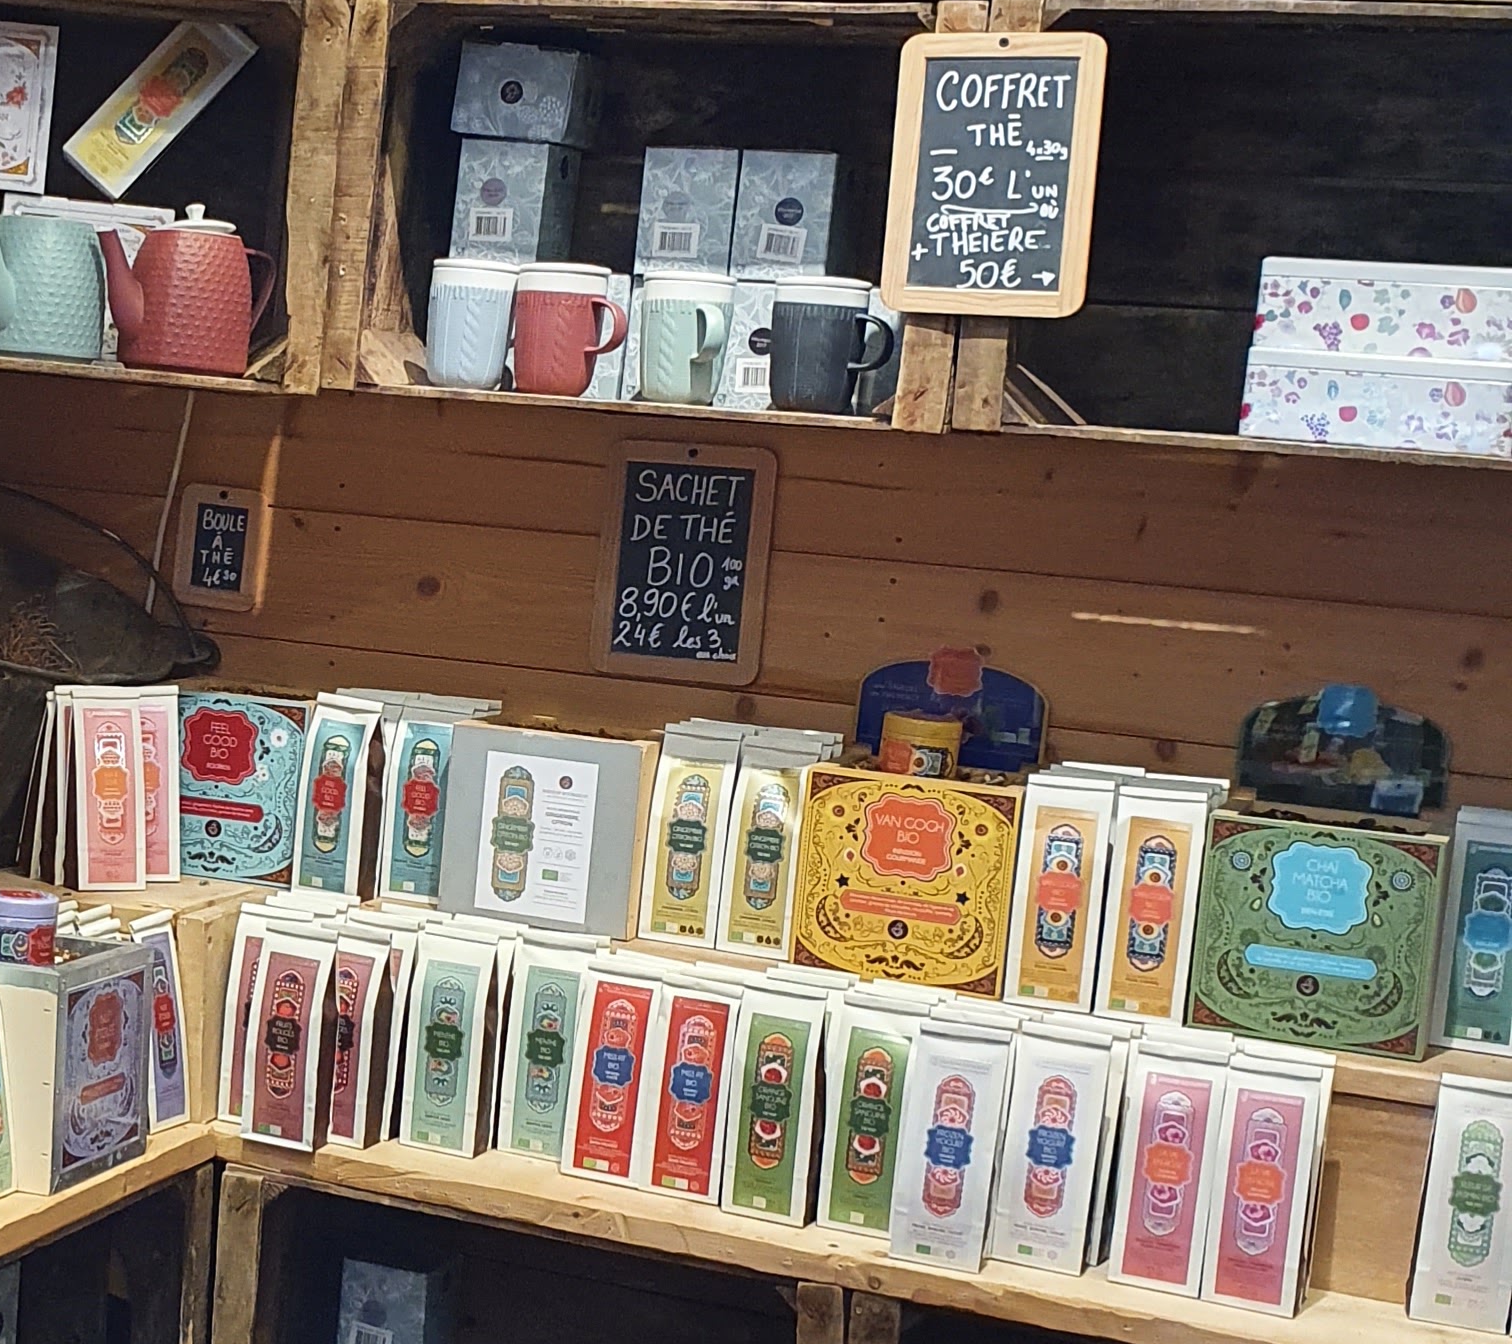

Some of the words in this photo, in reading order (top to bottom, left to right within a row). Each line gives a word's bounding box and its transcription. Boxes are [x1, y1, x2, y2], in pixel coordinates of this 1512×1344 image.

[936, 70, 1072, 112] COFFRET
[931, 165, 995, 201] 30€
[955, 258, 1022, 290] 50€
[635, 469, 745, 507] SACHET
[202, 509, 245, 532] BOULE
[630, 514, 672, 542] DE
[680, 511, 737, 544] THÉ
[646, 546, 714, 588] BIO
[613, 620, 666, 650] 24€
[707, 628, 722, 649] 3
[210, 721, 231, 735] FEEL
[210, 747, 229, 759] BIO
[875, 813, 901, 828] VAN
[897, 830, 920, 844] BIO
[1292, 872, 1348, 890] MATCHA
[1306, 889, 1331, 904] BIO
